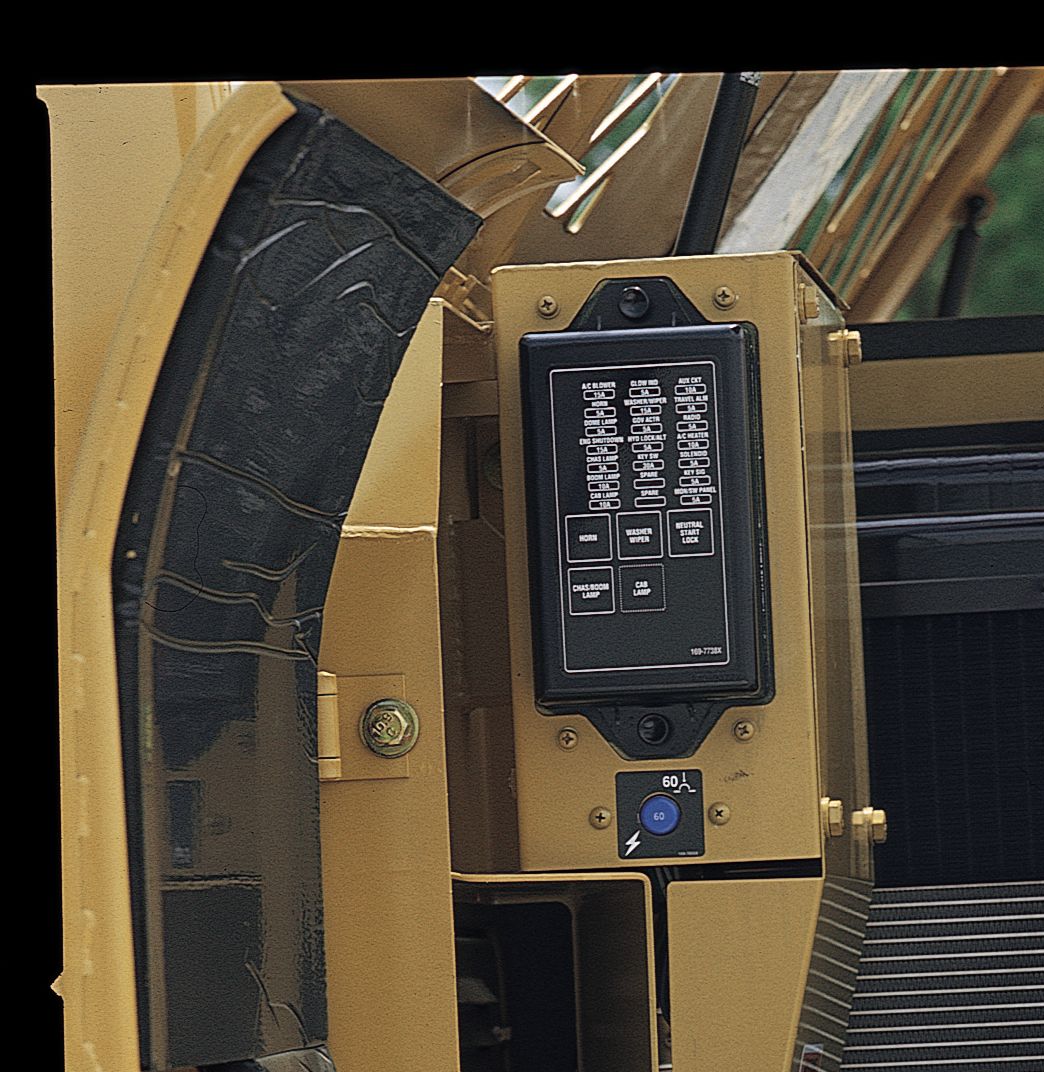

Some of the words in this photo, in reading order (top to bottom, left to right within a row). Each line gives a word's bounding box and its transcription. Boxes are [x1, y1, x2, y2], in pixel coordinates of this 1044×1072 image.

[592, 381, 616, 389] BLOWER
[624, 397, 667, 406] WASHER/WIPER
[592, 436, 624, 444] SHUTDOWN
[676, 521, 704, 529] NEUTRAL
[626, 528, 653, 536] WASHER
[680, 528, 700, 536] START
[579, 534, 598, 542] HORN
[629, 535, 650, 543] WIPER
[682, 536, 699, 544] LOCK
[572, 583, 609, 592] CHAS/BOOM
[582, 591, 601, 599] LAMP
[633, 588, 652, 596] LAMP
[662, 775, 679, 788] 60
[653, 811, 665, 821] 60
